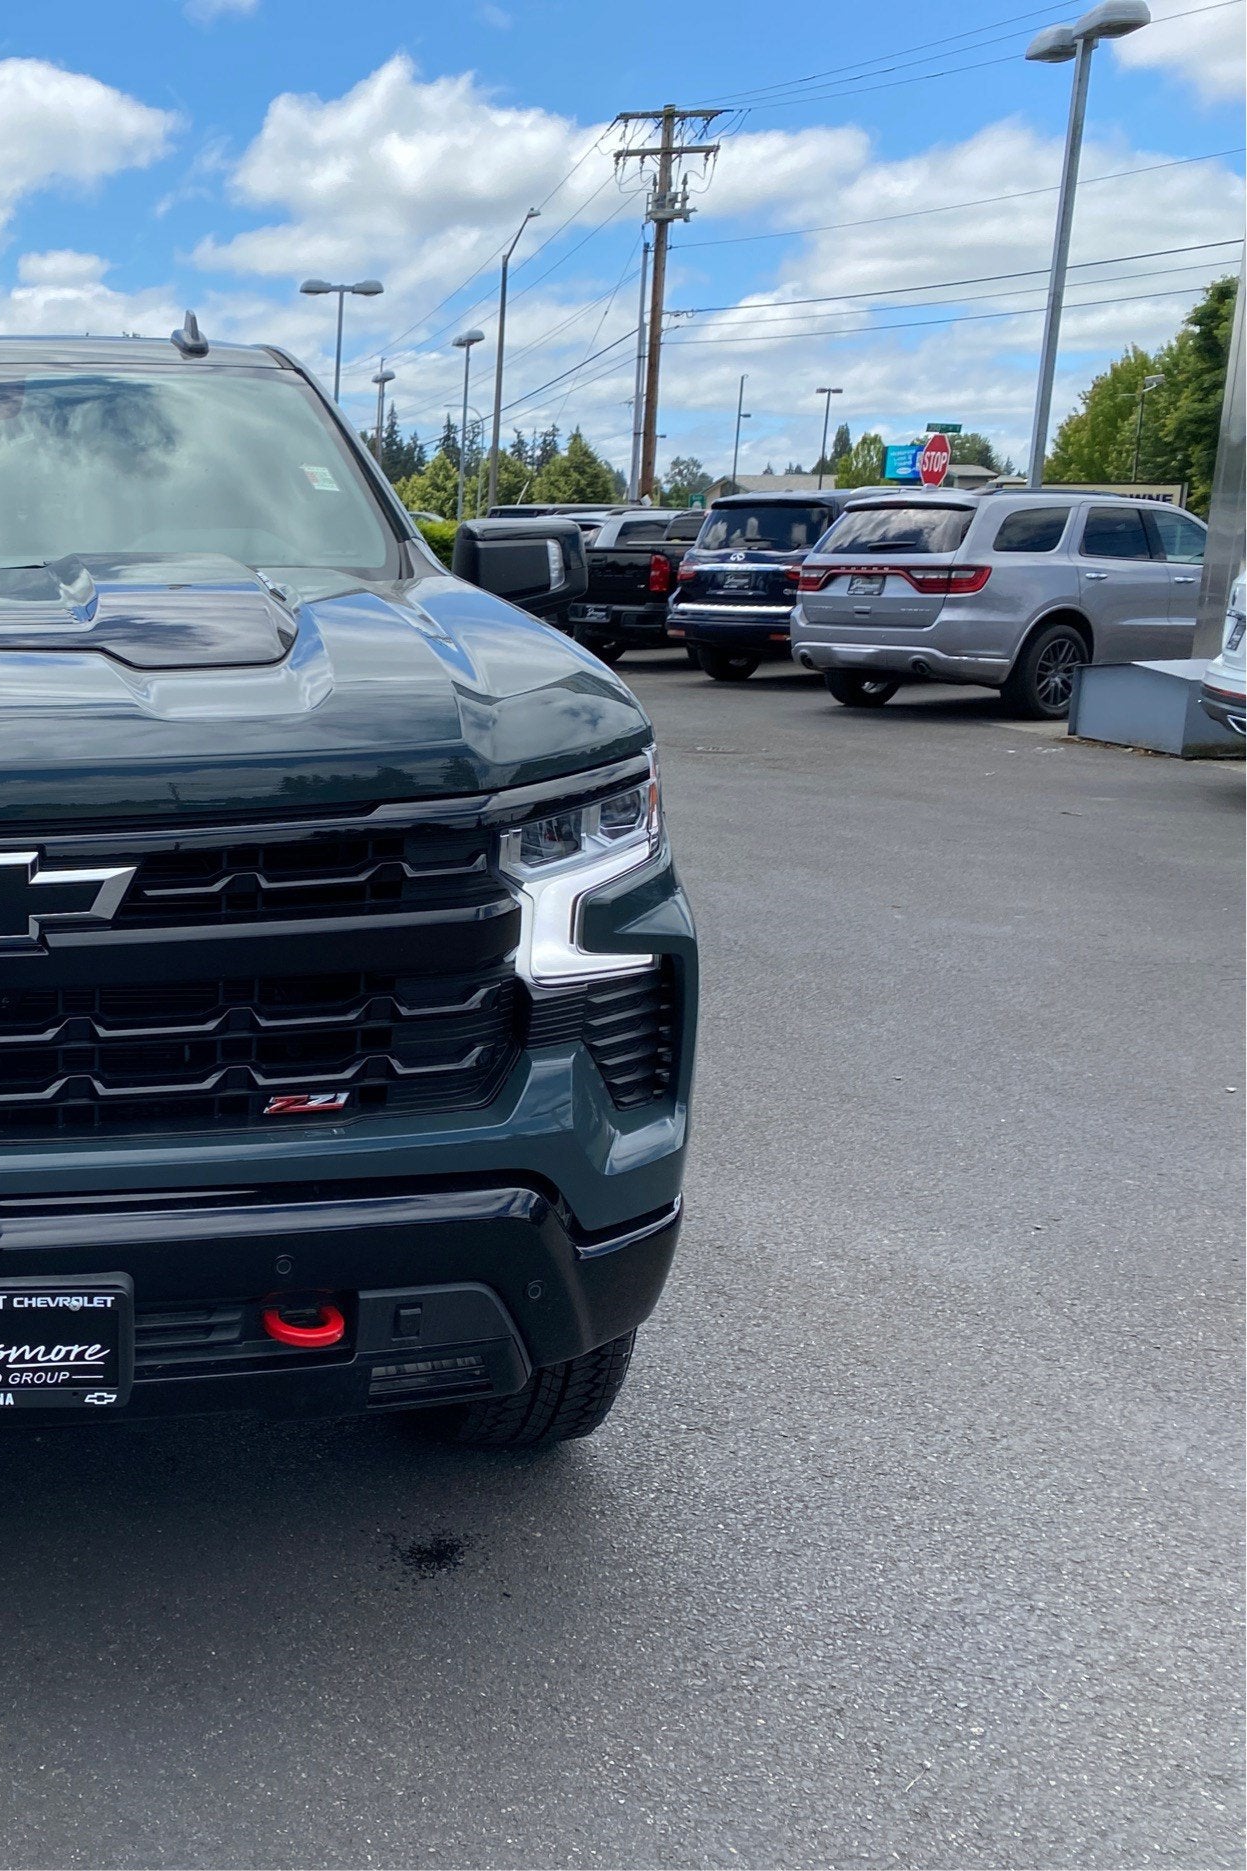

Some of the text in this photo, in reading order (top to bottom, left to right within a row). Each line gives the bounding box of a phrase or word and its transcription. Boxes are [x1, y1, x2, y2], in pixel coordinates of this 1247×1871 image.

[922, 451, 948, 472] STOP
[13, 1296, 115, 1309] CHEVROLET
[8, 1371, 70, 1385] GROUP
